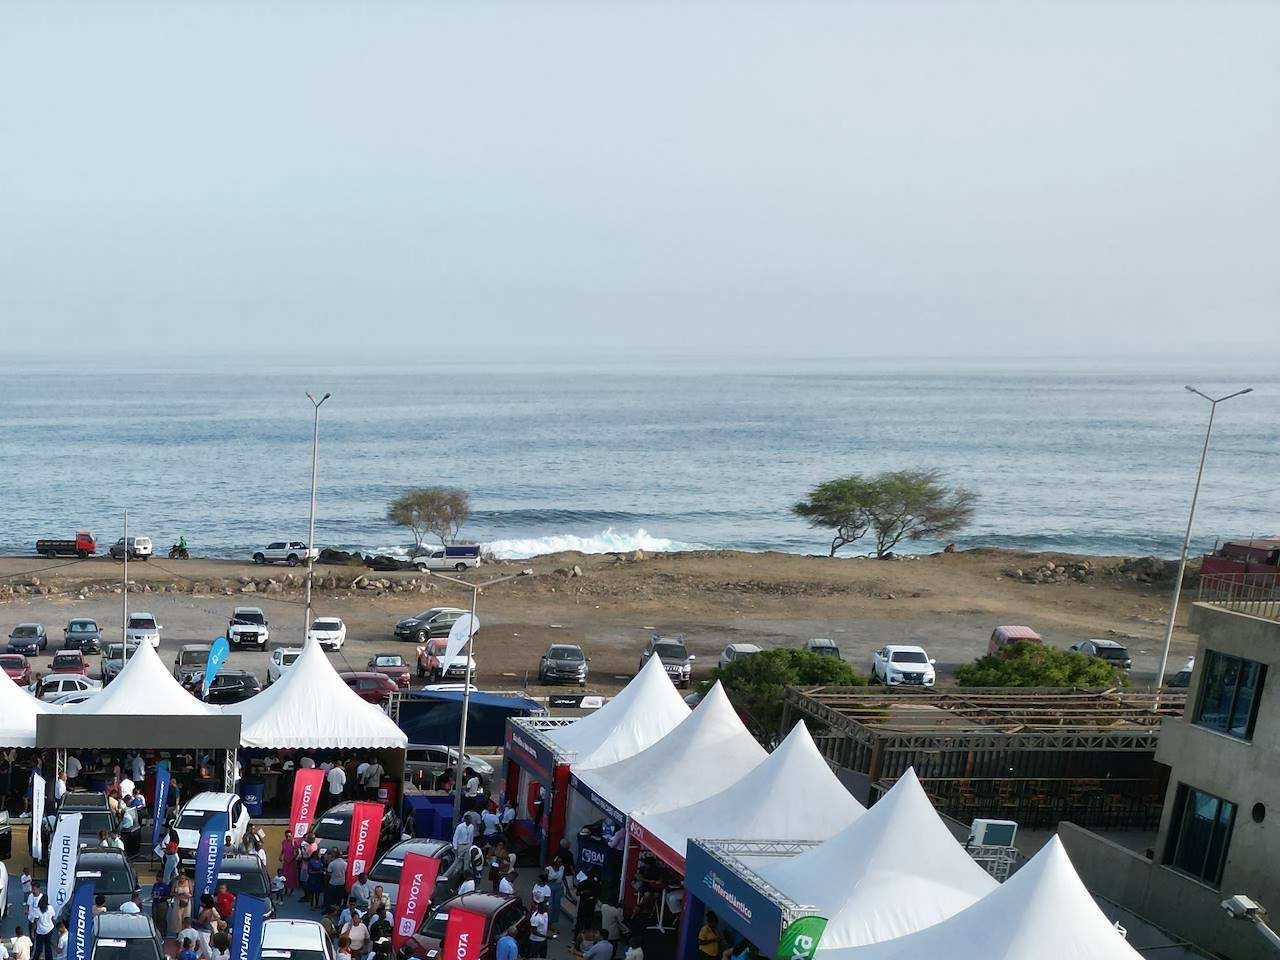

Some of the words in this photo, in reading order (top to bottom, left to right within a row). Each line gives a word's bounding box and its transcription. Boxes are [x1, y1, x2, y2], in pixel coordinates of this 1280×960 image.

[300, 784, 312, 820] TOYOTA
[207, 834, 218, 883] HYUNDAI
[356, 819, 370, 856] TOYOTA
[59, 835, 71, 885] HYUNDAI
[406, 873, 423, 915] TOYOTA
